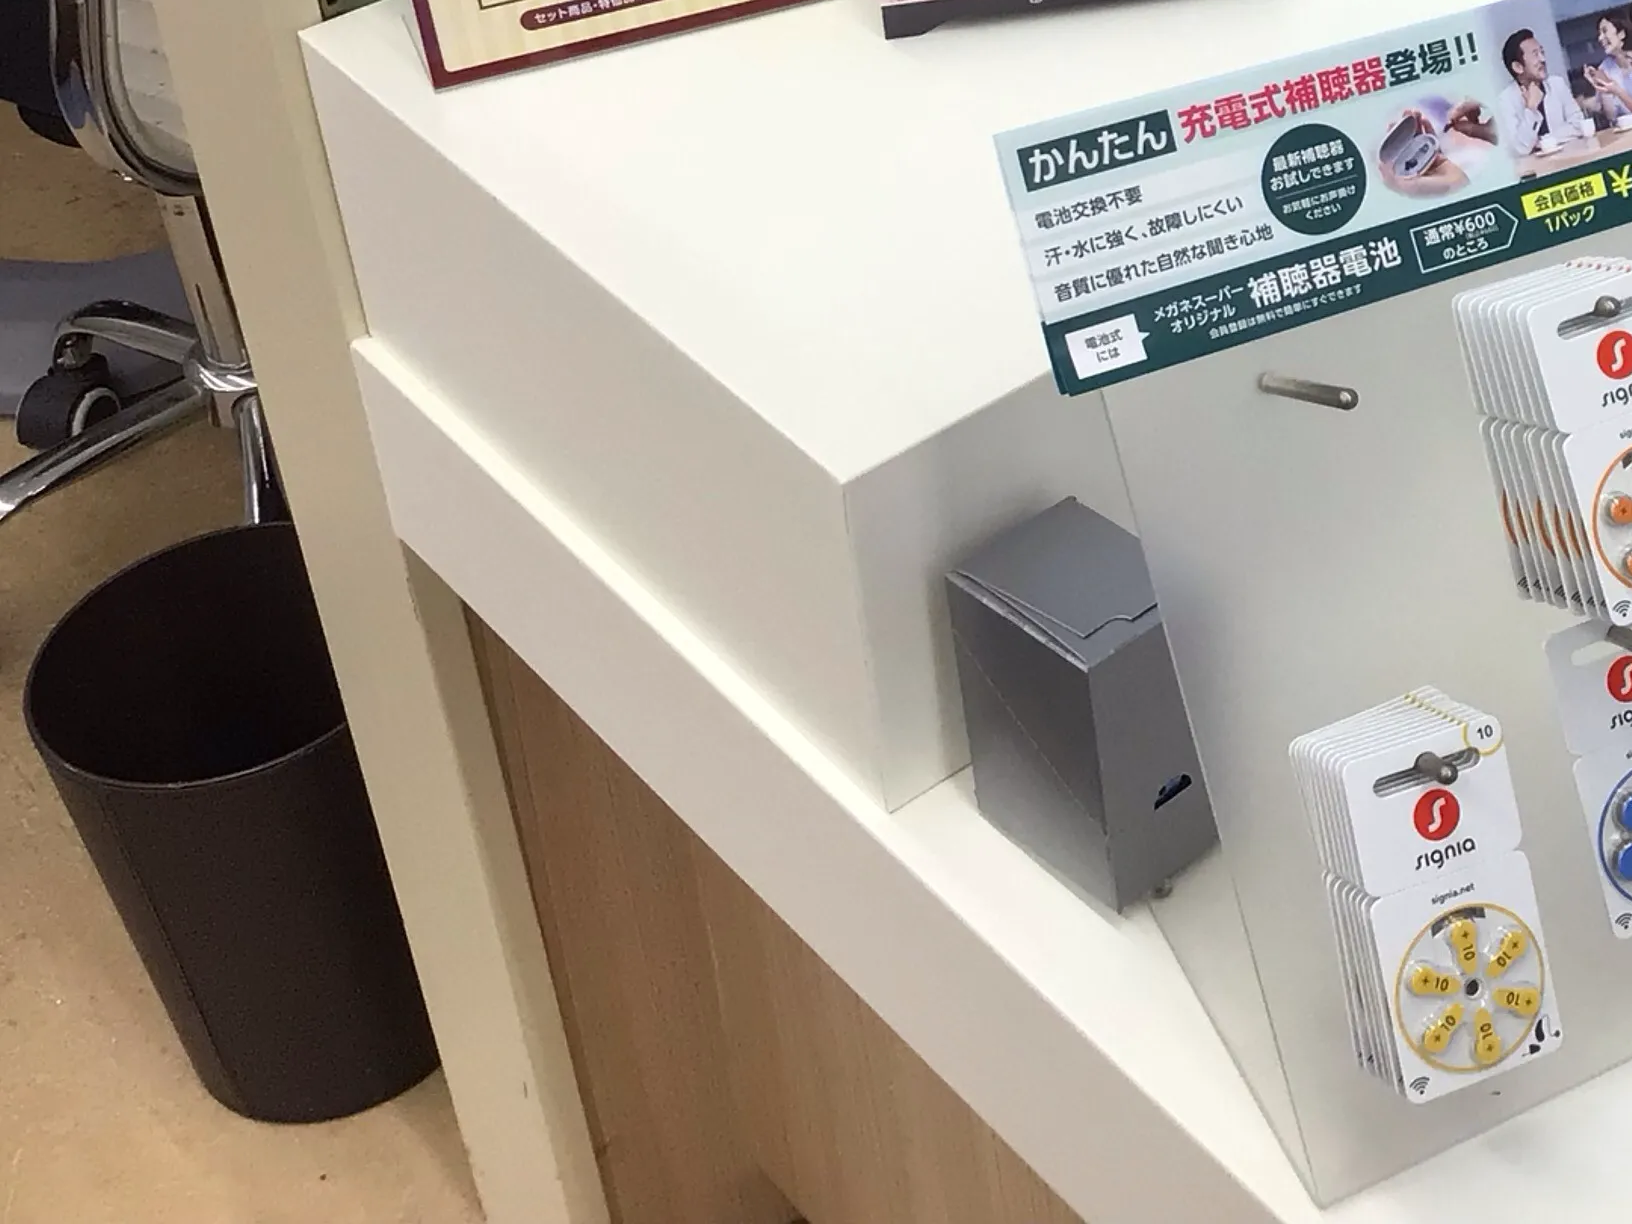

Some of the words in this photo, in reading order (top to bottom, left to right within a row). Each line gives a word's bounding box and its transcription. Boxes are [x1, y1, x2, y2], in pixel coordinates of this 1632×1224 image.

[1028, 120, 1167, 184] かんたん
[1272, 139, 1346, 173] 最新補聴器
[1269, 156, 1355, 192] お試しできます
[1034, 185, 1144, 230] 電池交換不要
[1304, 203, 1342, 221] ください
[1533, 181, 1596, 212] 会員価格
[1043, 196, 1244, 267] 汗・水に強く、故障しにくい
[1423, 210, 1497, 247] 通常¥600
[1544, 204, 1596, 233] 1パック
[1053, 223, 1275, 303] 音質に優れた自然な聞き心地
[1442, 237, 1490, 260] のところ
[1247, 235, 1402, 310] 補聴器電池
[1152, 283, 1245, 323] メガネスーパー
[1170, 303, 1237, 334] オリジナル
[1084, 329, 1123, 351] 電池式
[1096, 347, 1121, 363] には
[1476, 724, 1495, 741] 10
[1414, 837, 1476, 872] signia
[1430, 882, 1476, 907] signia.net
